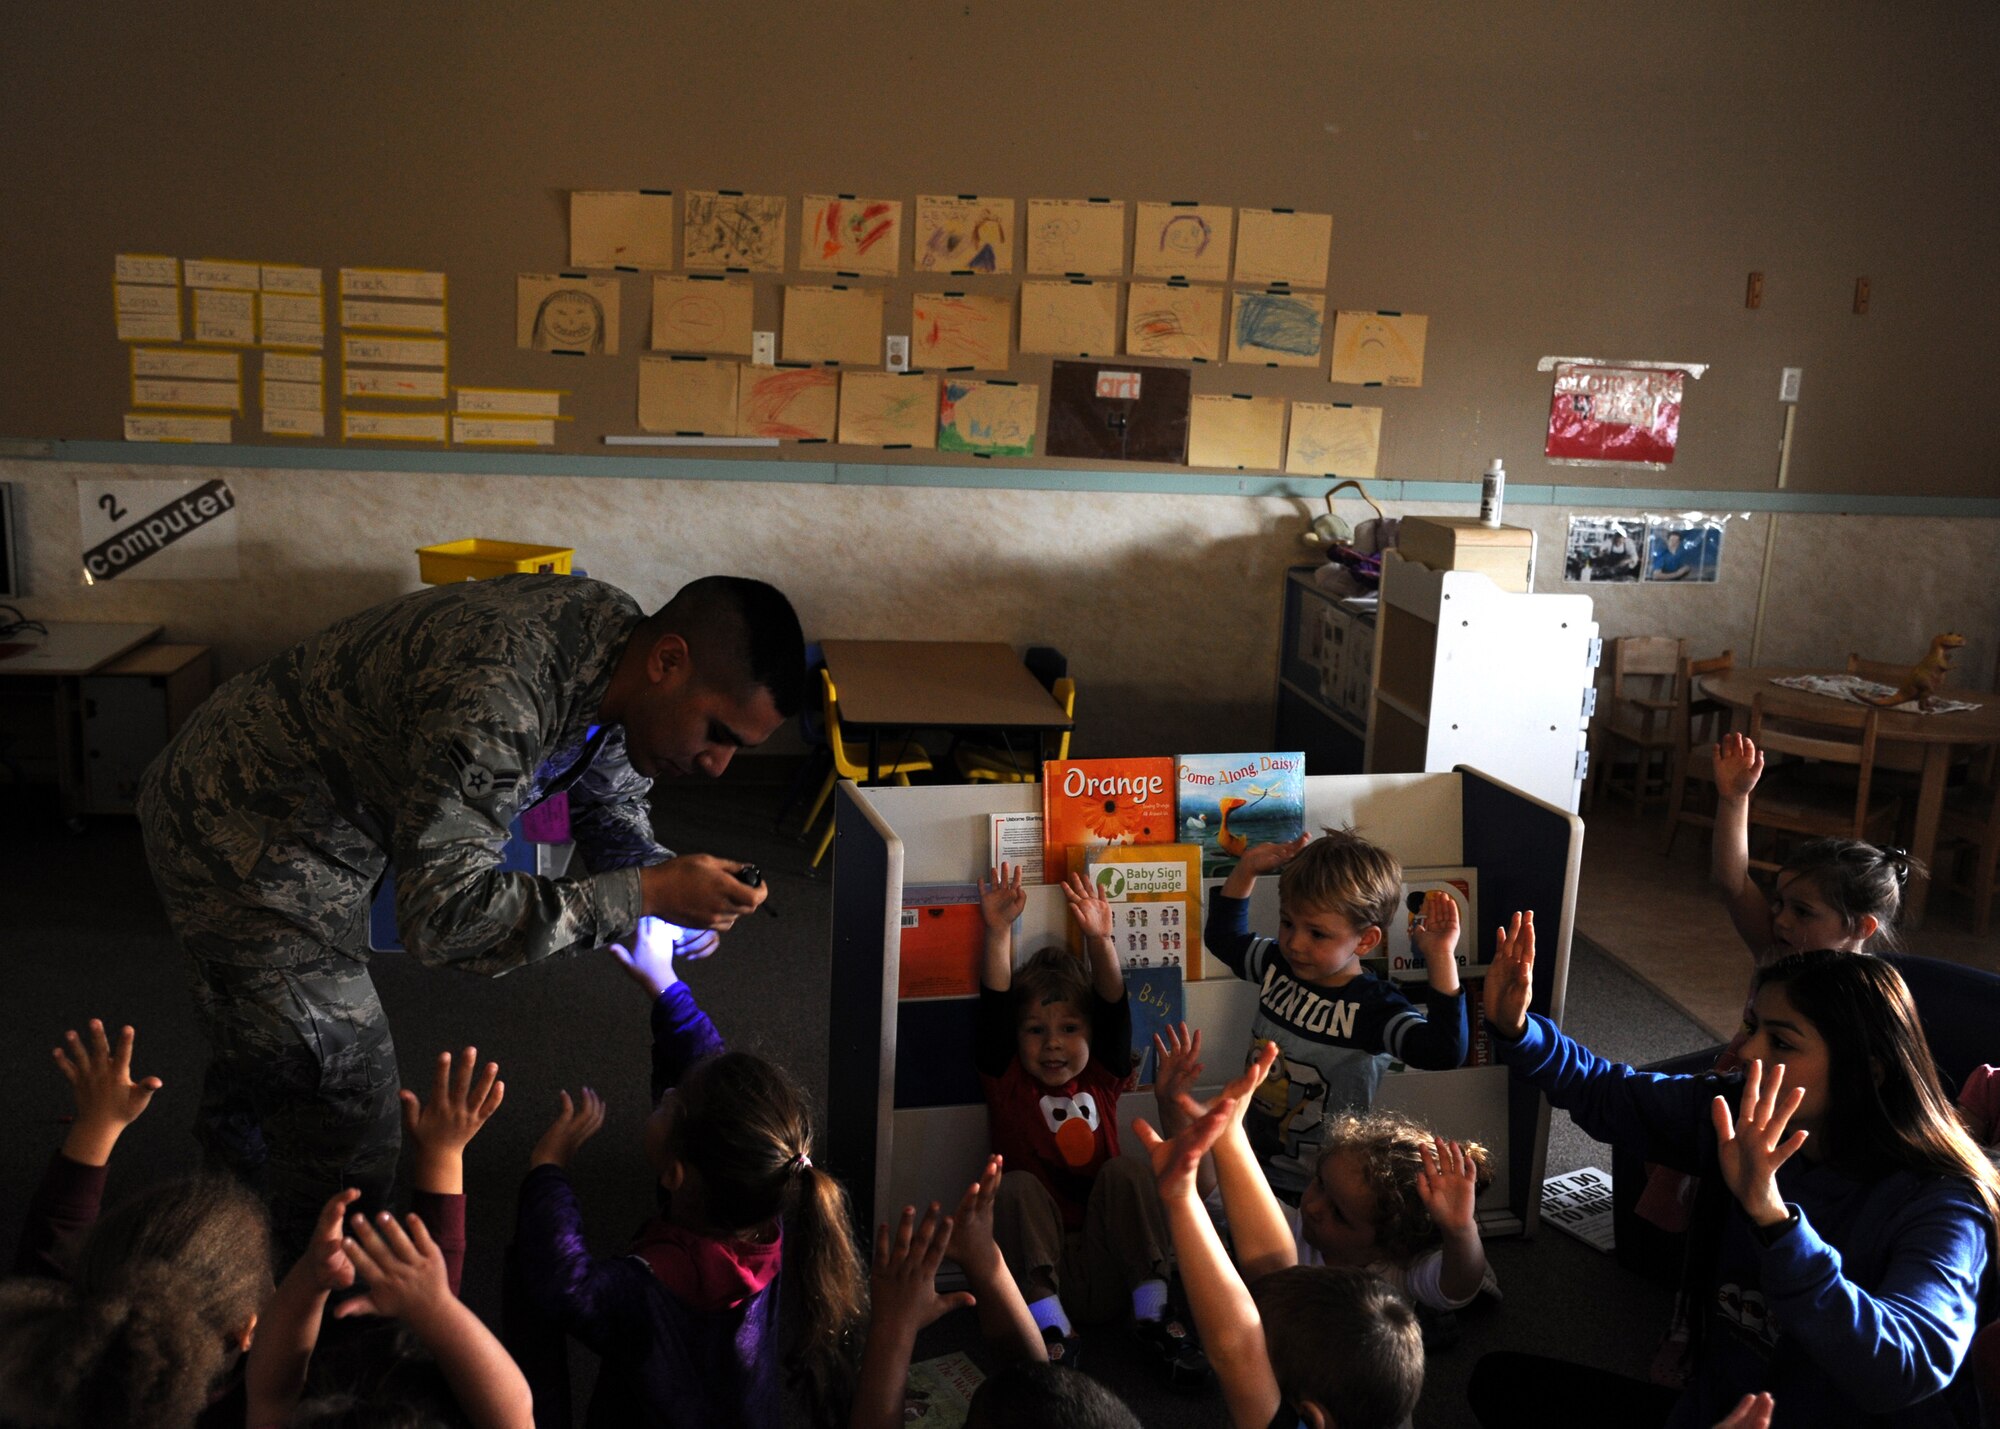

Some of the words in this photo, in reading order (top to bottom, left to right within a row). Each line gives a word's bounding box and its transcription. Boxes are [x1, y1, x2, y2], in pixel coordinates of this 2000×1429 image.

[1096, 373, 1138, 397] art
[1107, 412, 1126, 437] 4
[99, 494, 127, 522] 2
[87, 486, 230, 576] computer
[1177, 765, 1215, 785] Come
[1218, 763, 1259, 785] Along,
[1260, 756, 1300, 773] Daisy!
[1063, 767, 1164, 804] Orange
[1126, 879, 1182, 893] Language
[1127, 868, 1155, 880] Baby
[1157, 867, 1182, 881] Sign
[1138, 982, 1172, 1017] Baby
[1260, 963, 1361, 1040] MINION
[1541, 1180, 1574, 1200] HY
[1567, 1173, 1601, 1187] DO
[1565, 1183, 1613, 1204] HAVE
[1550, 1209, 1584, 1224] TO
